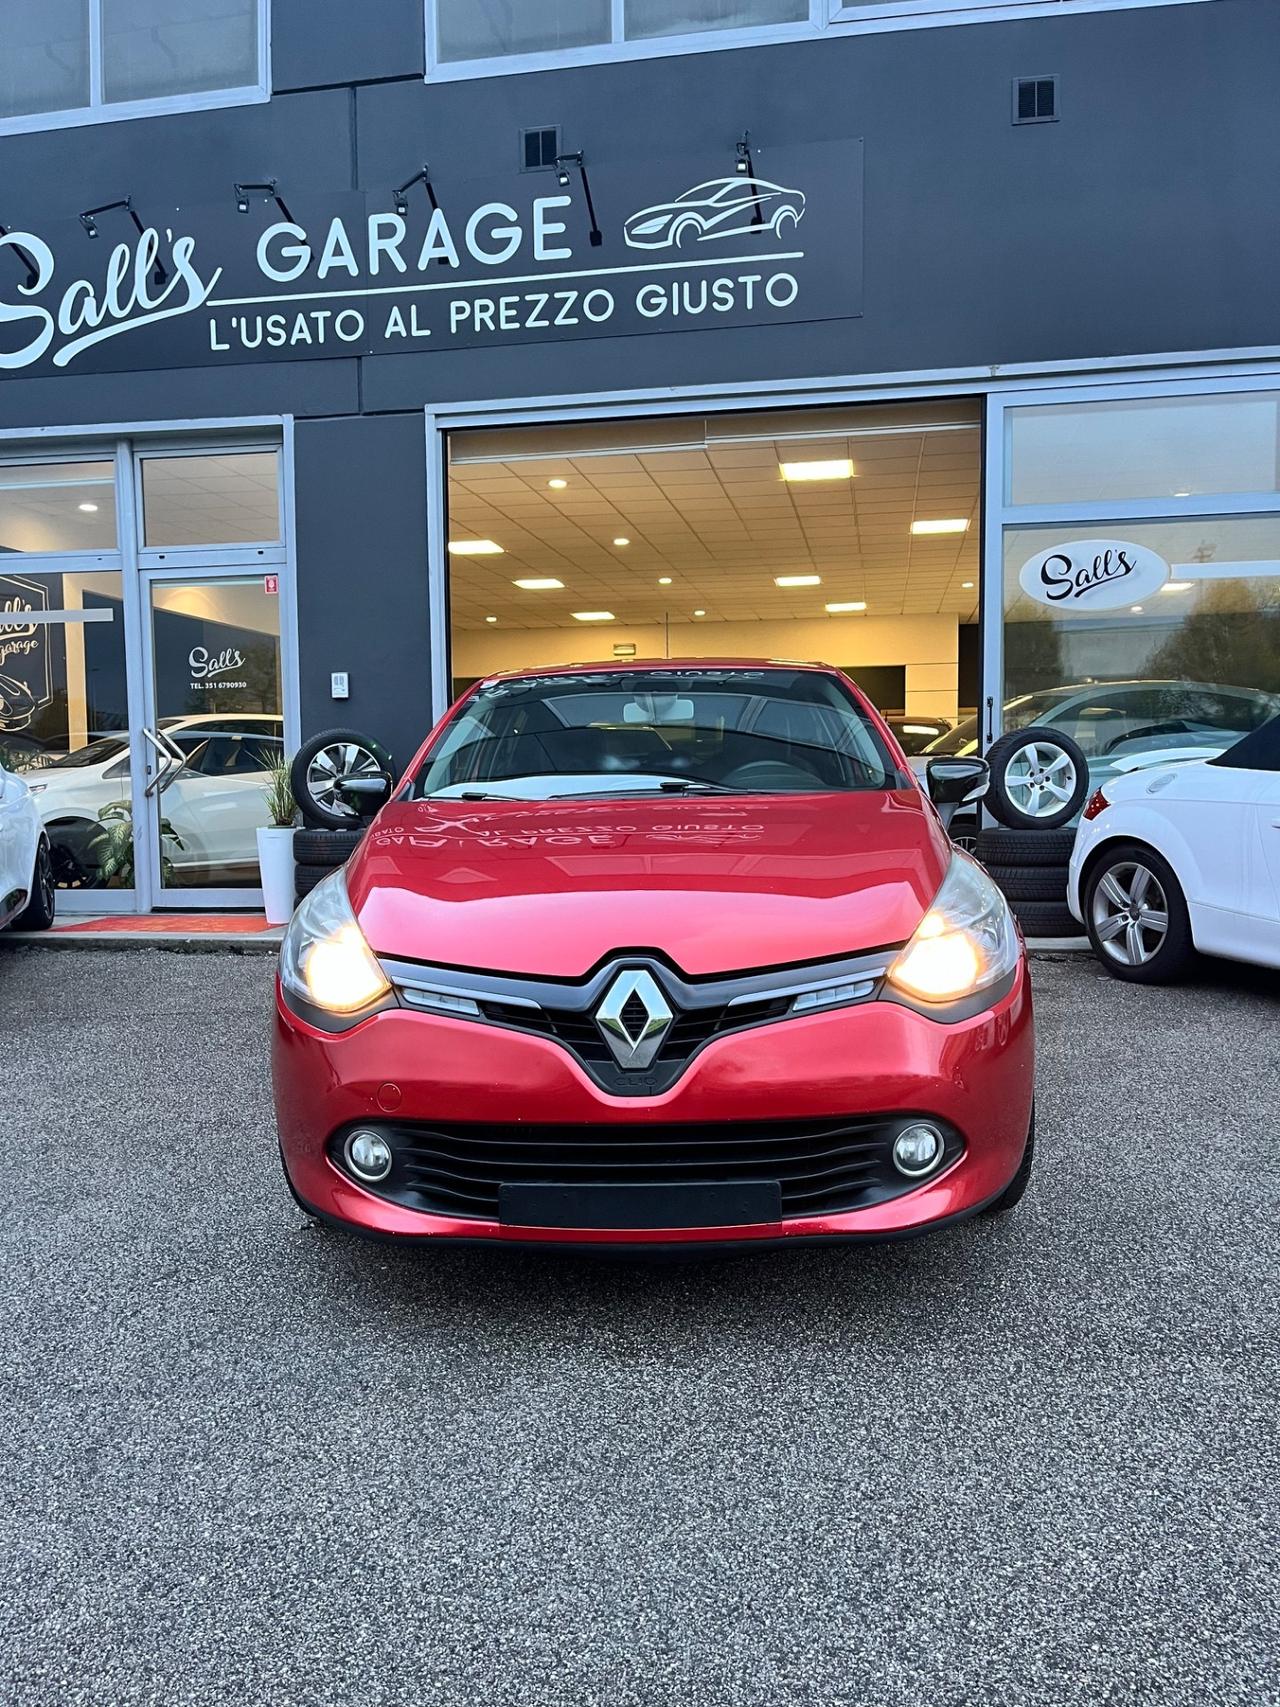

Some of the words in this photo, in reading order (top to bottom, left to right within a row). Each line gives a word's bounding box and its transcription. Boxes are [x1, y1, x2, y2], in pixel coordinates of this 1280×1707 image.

[0, 228, 222, 369] Sall's
[256, 196, 573, 282] GARAGE
[210, 309, 364, 350] L'USATO
[384, 304, 431, 338] AL
[450, 288, 614, 334] PREZZO
[636, 273, 798, 317] GIUSTO
[1041, 549, 1137, 600] Sall's
[188, 646, 246, 678] Sall's
